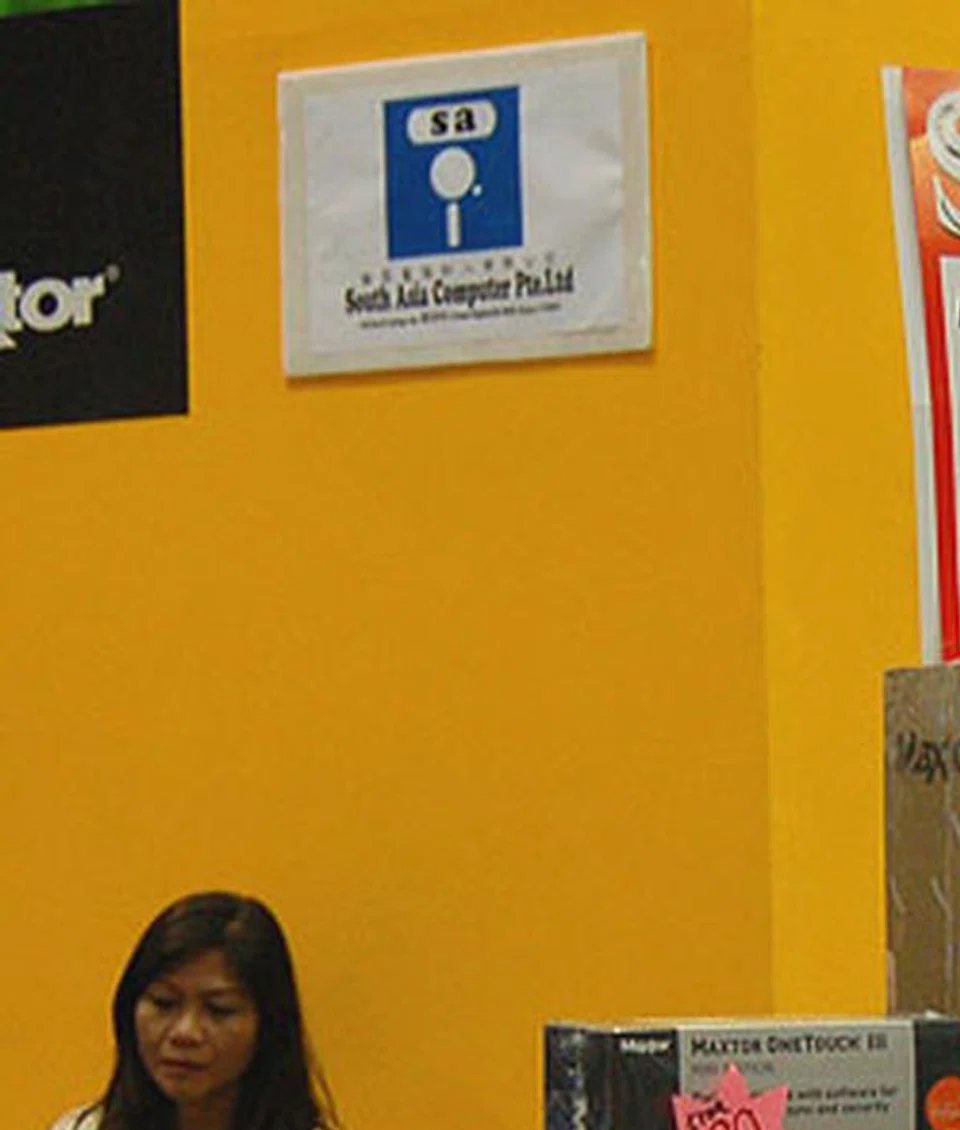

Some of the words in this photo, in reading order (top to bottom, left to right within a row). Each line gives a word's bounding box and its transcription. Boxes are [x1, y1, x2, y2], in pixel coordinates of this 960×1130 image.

[430, 106, 476, 135] sa
[396, 281, 429, 310] Asia
[432, 279, 511, 309] Computer
[691, 1036, 761, 1055] MAXTOR
